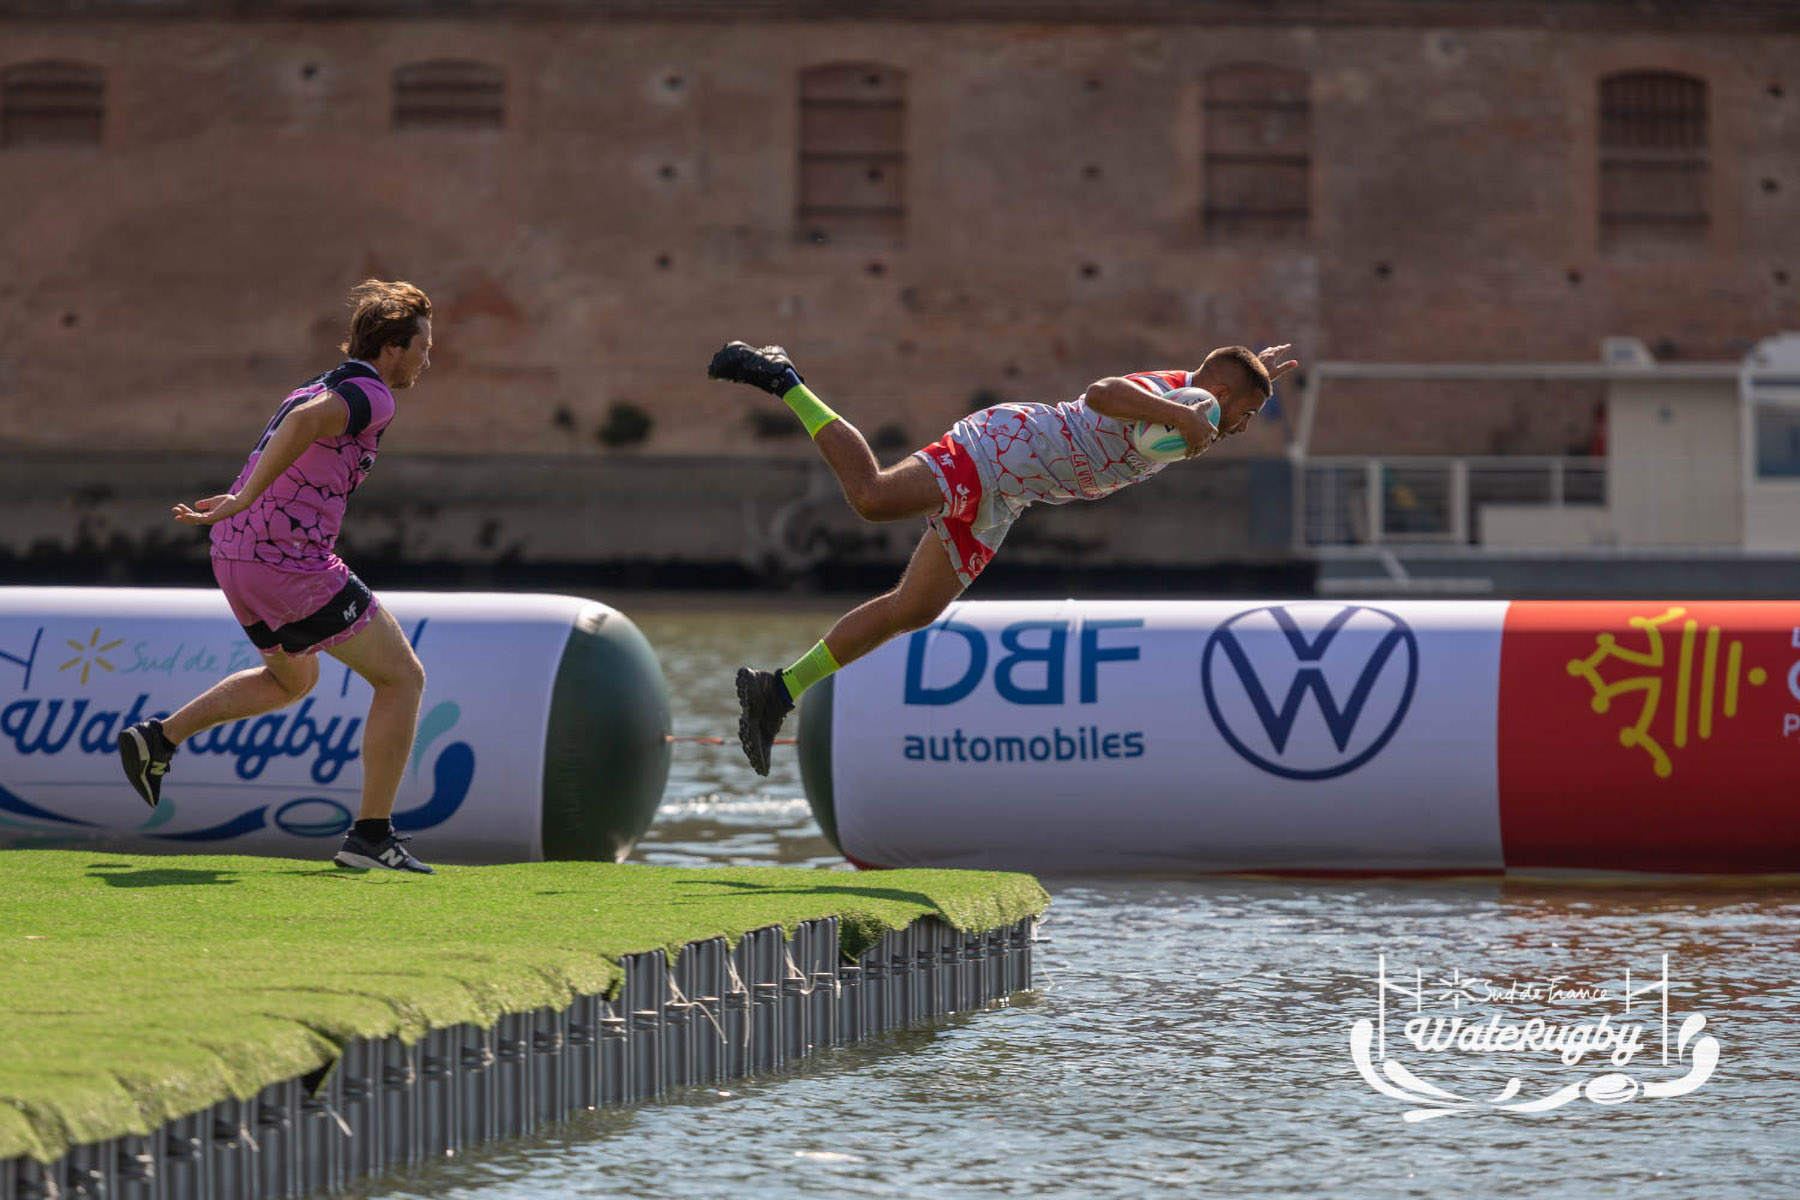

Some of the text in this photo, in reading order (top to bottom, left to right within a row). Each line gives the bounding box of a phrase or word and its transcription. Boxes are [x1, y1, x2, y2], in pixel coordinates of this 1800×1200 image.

[120, 642, 185, 677] Sud
[904, 617, 1145, 706] DBF
[904, 726, 1145, 763] automobiles
